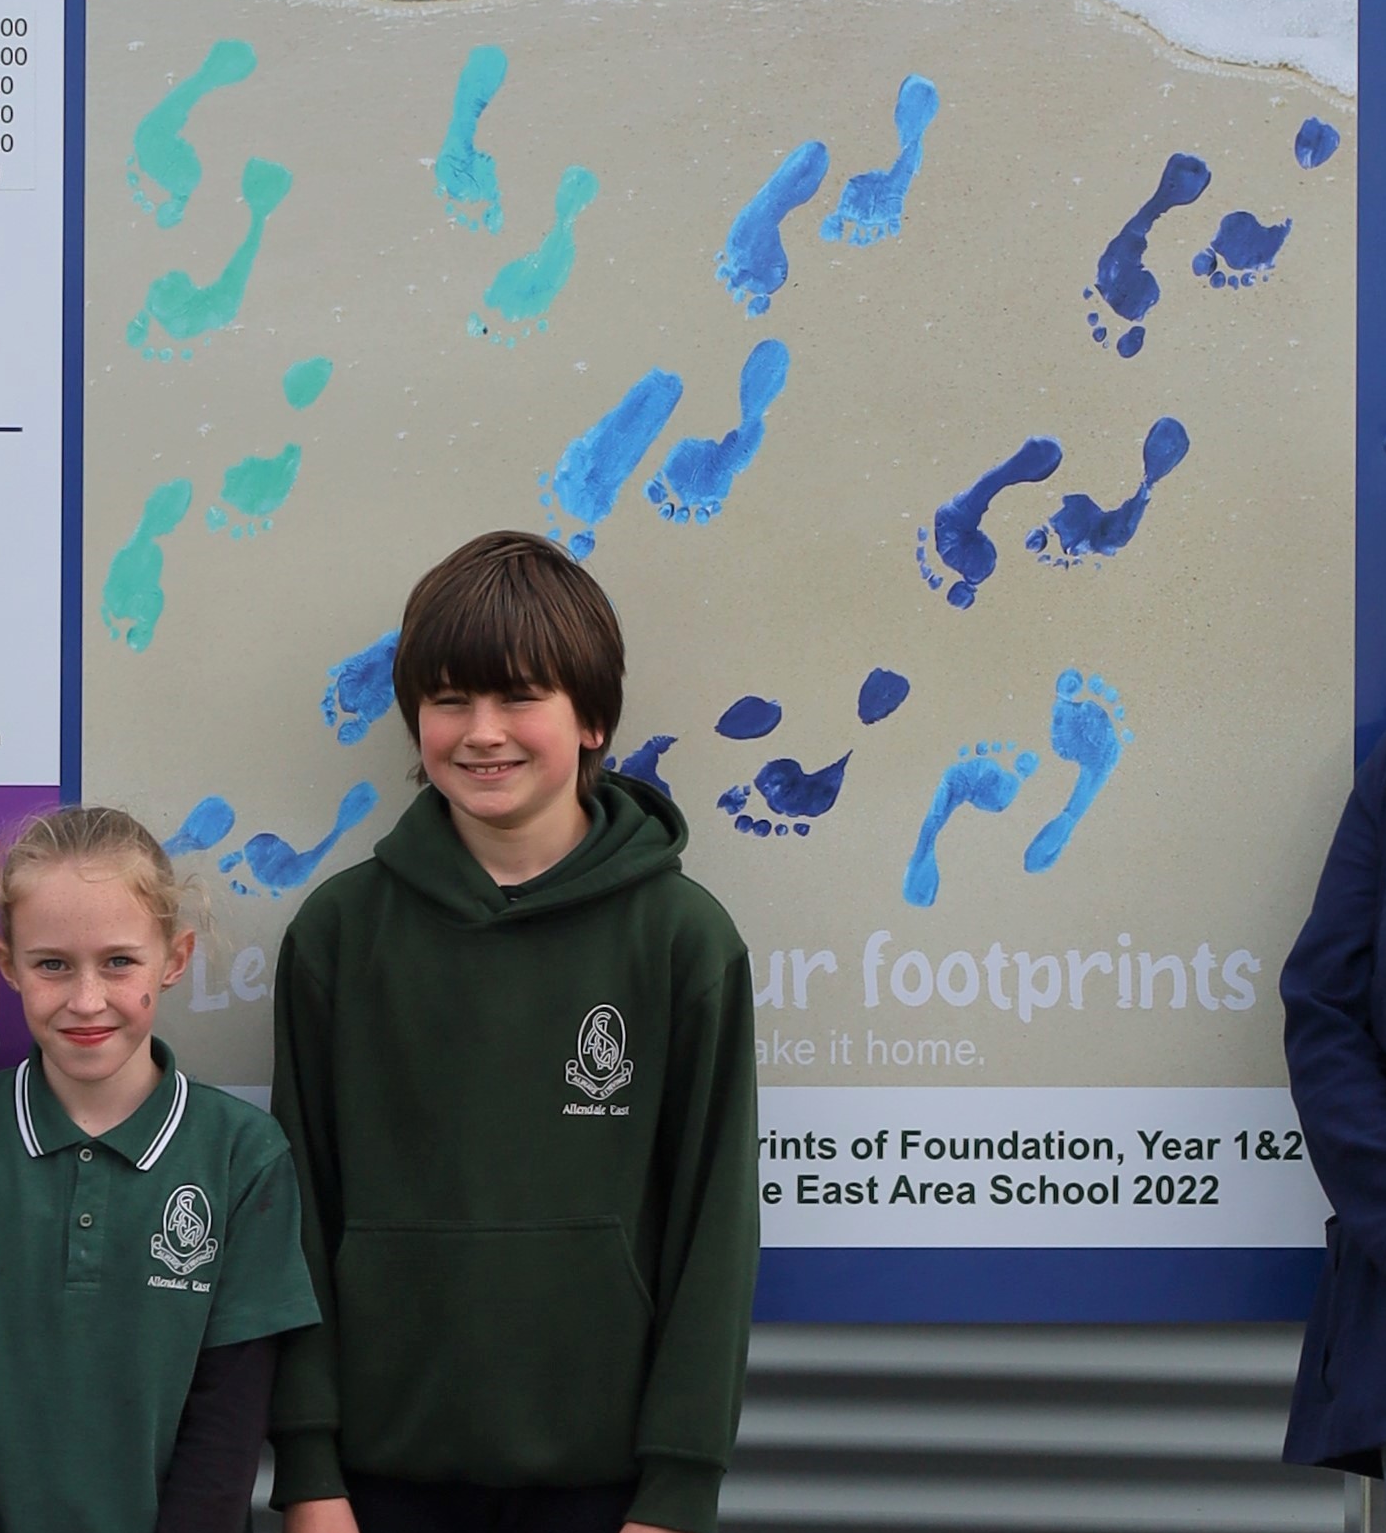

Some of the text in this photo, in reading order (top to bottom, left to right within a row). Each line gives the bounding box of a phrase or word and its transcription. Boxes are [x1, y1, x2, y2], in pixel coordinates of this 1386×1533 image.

[863, 929, 1261, 1023] footprints
[755, 1030, 986, 1066] ake it home.
[850, 1129, 889, 1160] of
[901, 1129, 1125, 1165] Foundation,
[1137, 1130, 1222, 1161] Year
[1234, 1131, 1303, 1161] 1&2
[797, 1175, 880, 1205] East
[888, 1175, 977, 1205] Area
[989, 1174, 1120, 1205] School
[1133, 1176, 1220, 1205] 2022
